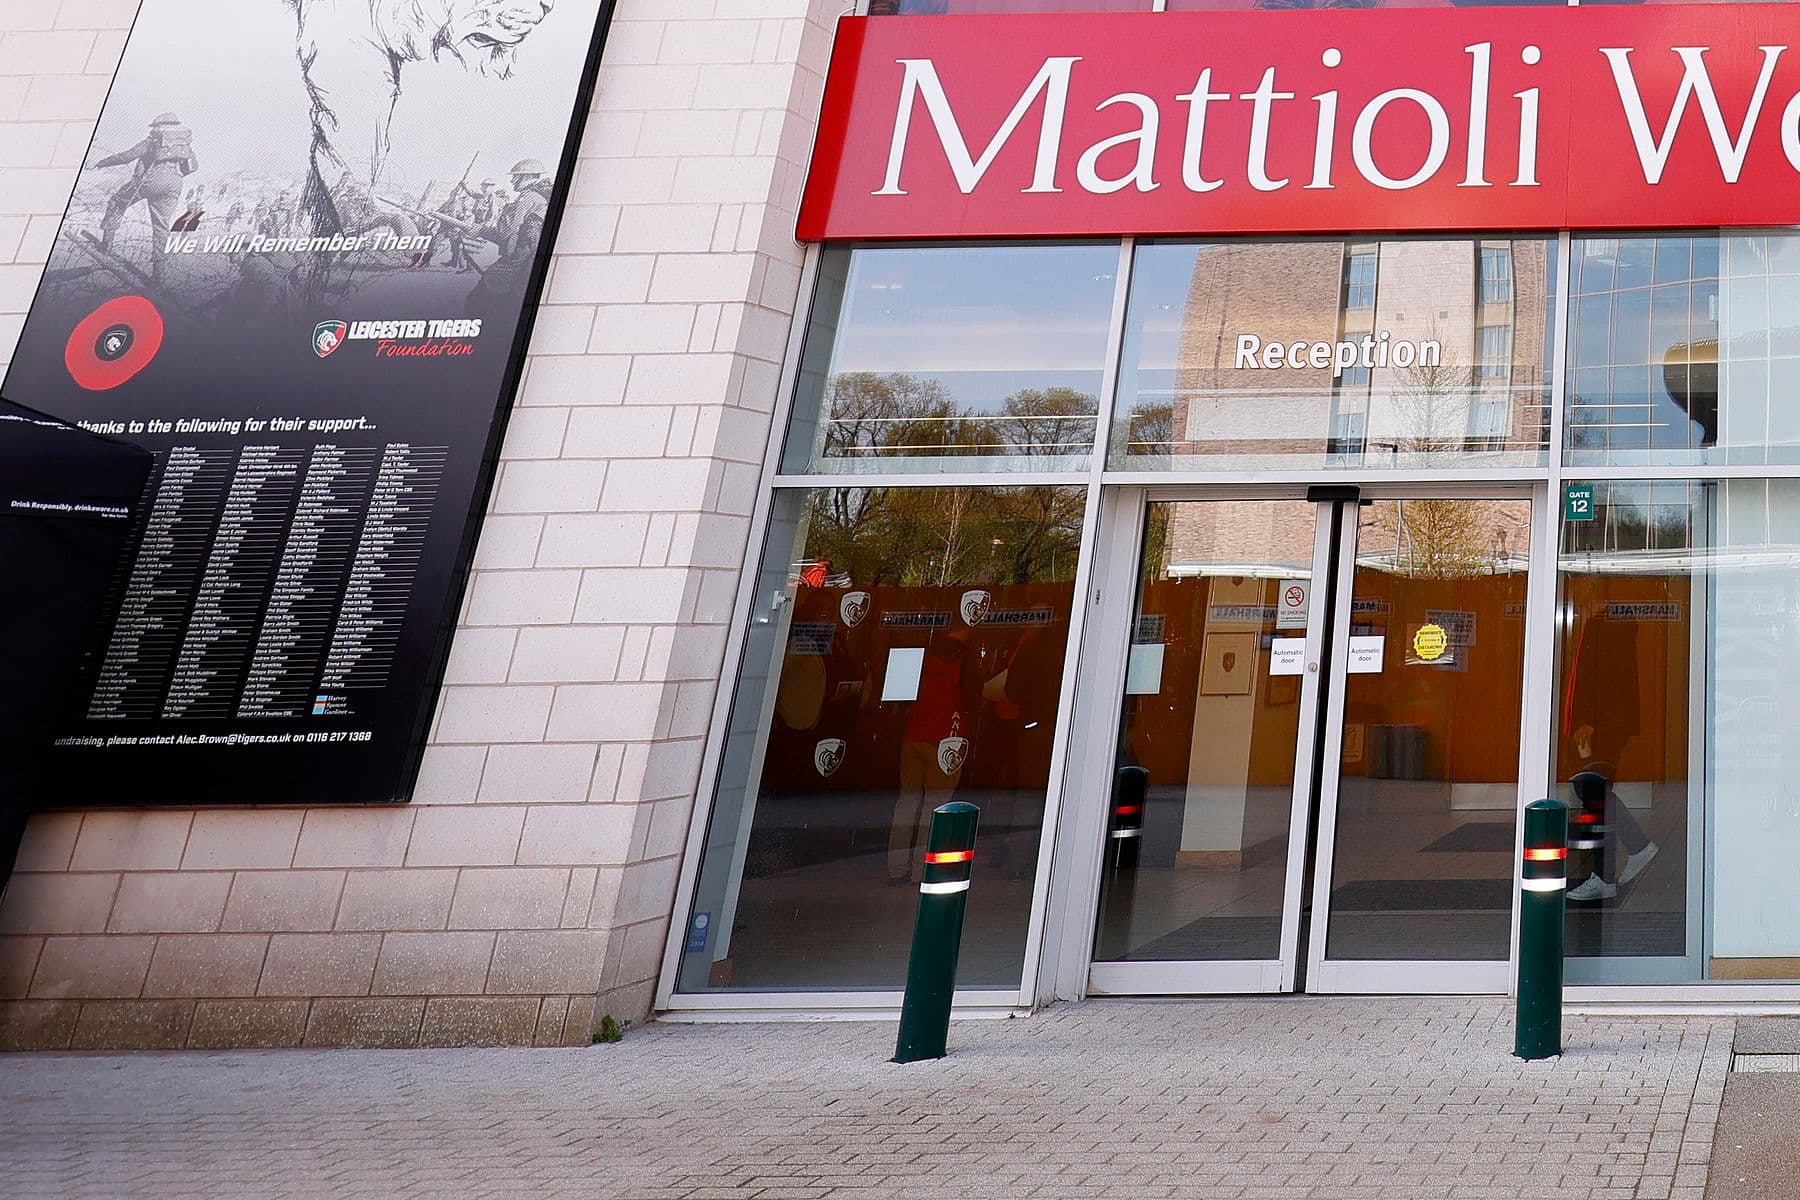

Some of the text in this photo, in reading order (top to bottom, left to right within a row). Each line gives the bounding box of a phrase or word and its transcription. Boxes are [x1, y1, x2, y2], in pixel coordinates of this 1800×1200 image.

[870, 43, 1542, 196] Mattioli
[164, 233, 432, 253] We Will Remember Them
[348, 319, 482, 339] LEICESTER TIGERS
[376, 339, 474, 357] Foundation
[1235, 331, 1443, 374] Reception
[128, 420, 144, 433] to
[147, 419, 172, 433] the
[175, 418, 240, 434] following
[244, 418, 266, 431] for
[269, 417, 304, 431] their
[308, 416, 377, 431] support...
[11, 500, 128, 513] Drink Responsibly. drinkaware.co.uk
[1571, 501, 1588, 512] 12
[107, 736, 137, 746] please
[139, 735, 175, 745] contact
[176, 733, 291, 745] Alec.Brown@tigers.co.uk
[293, 734, 305, 742] on
[306, 732, 328, 742] 0116
[329, 732, 347, 742] 217
